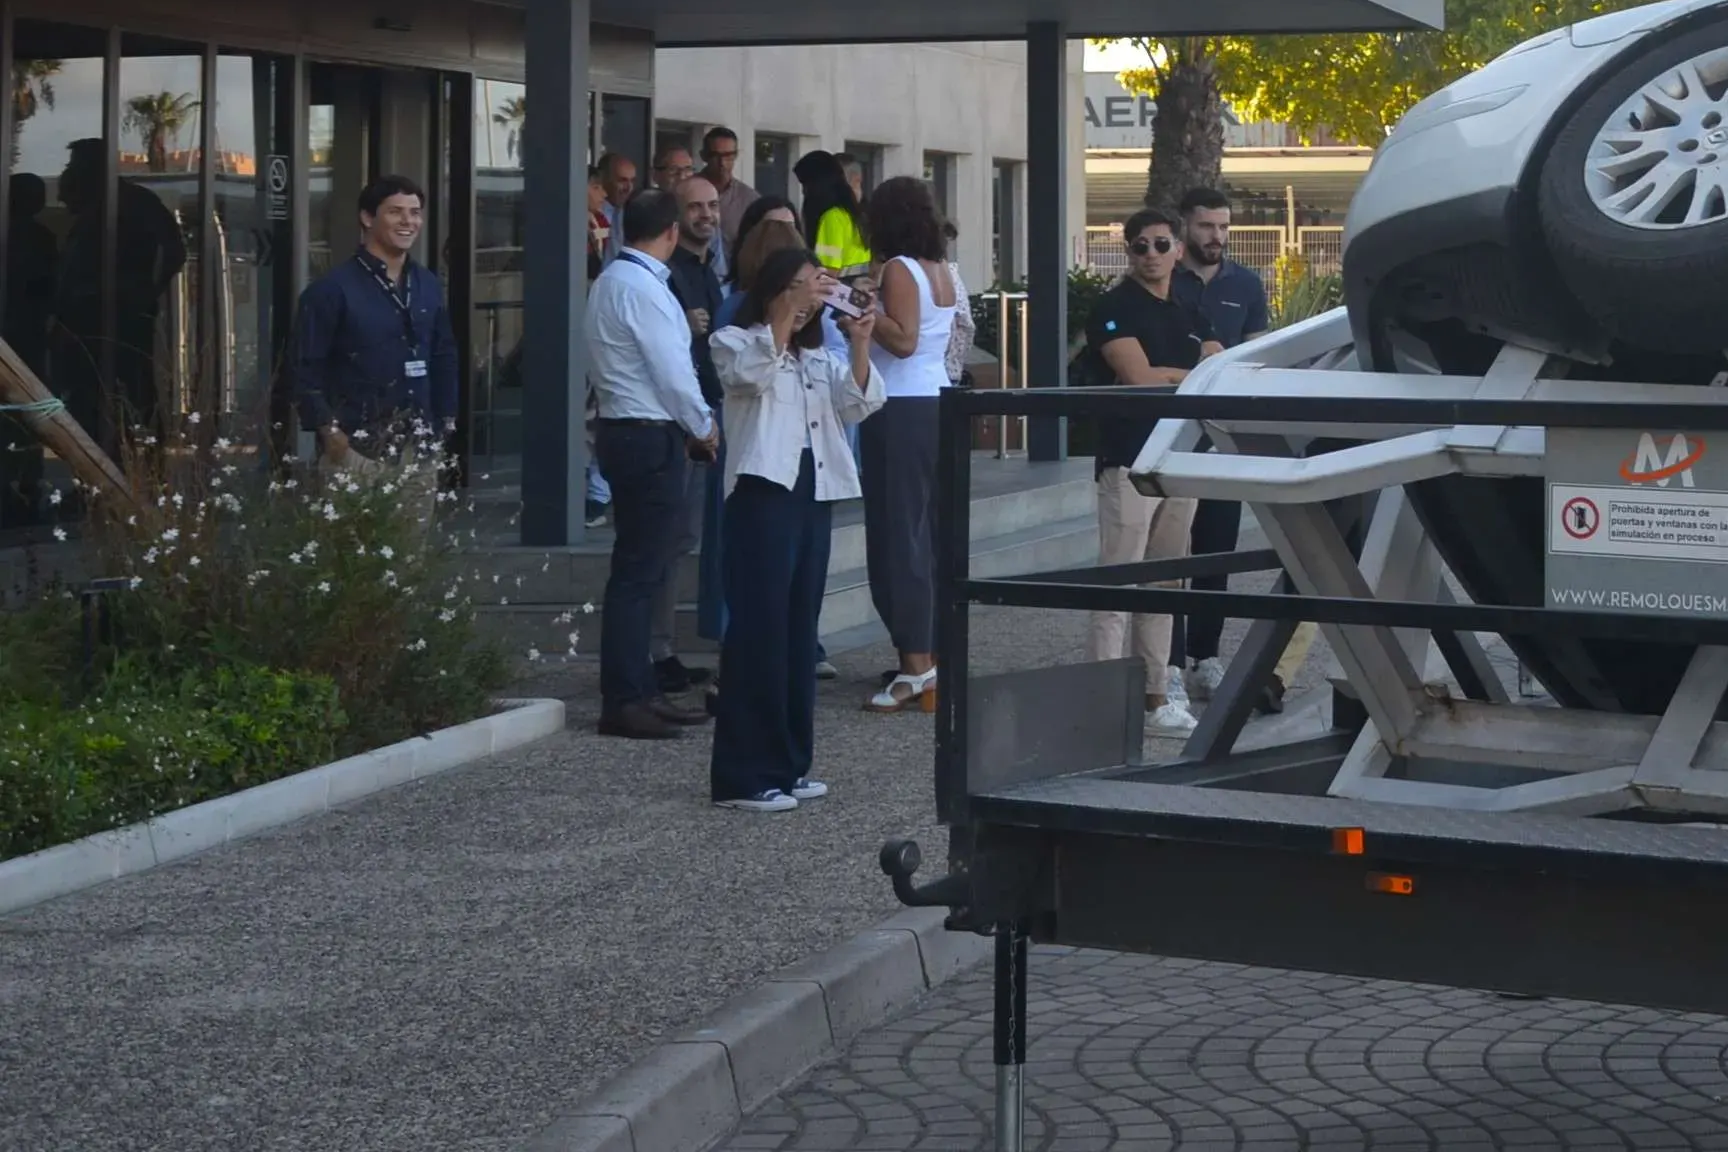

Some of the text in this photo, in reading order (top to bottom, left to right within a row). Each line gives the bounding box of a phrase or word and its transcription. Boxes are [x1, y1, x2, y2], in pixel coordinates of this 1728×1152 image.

[1611, 503, 1710, 518] Prohibida apertura de
[1611, 518, 1728, 531] puertas y ventanas con la
[1611, 529, 1715, 543] simulación en proceso
